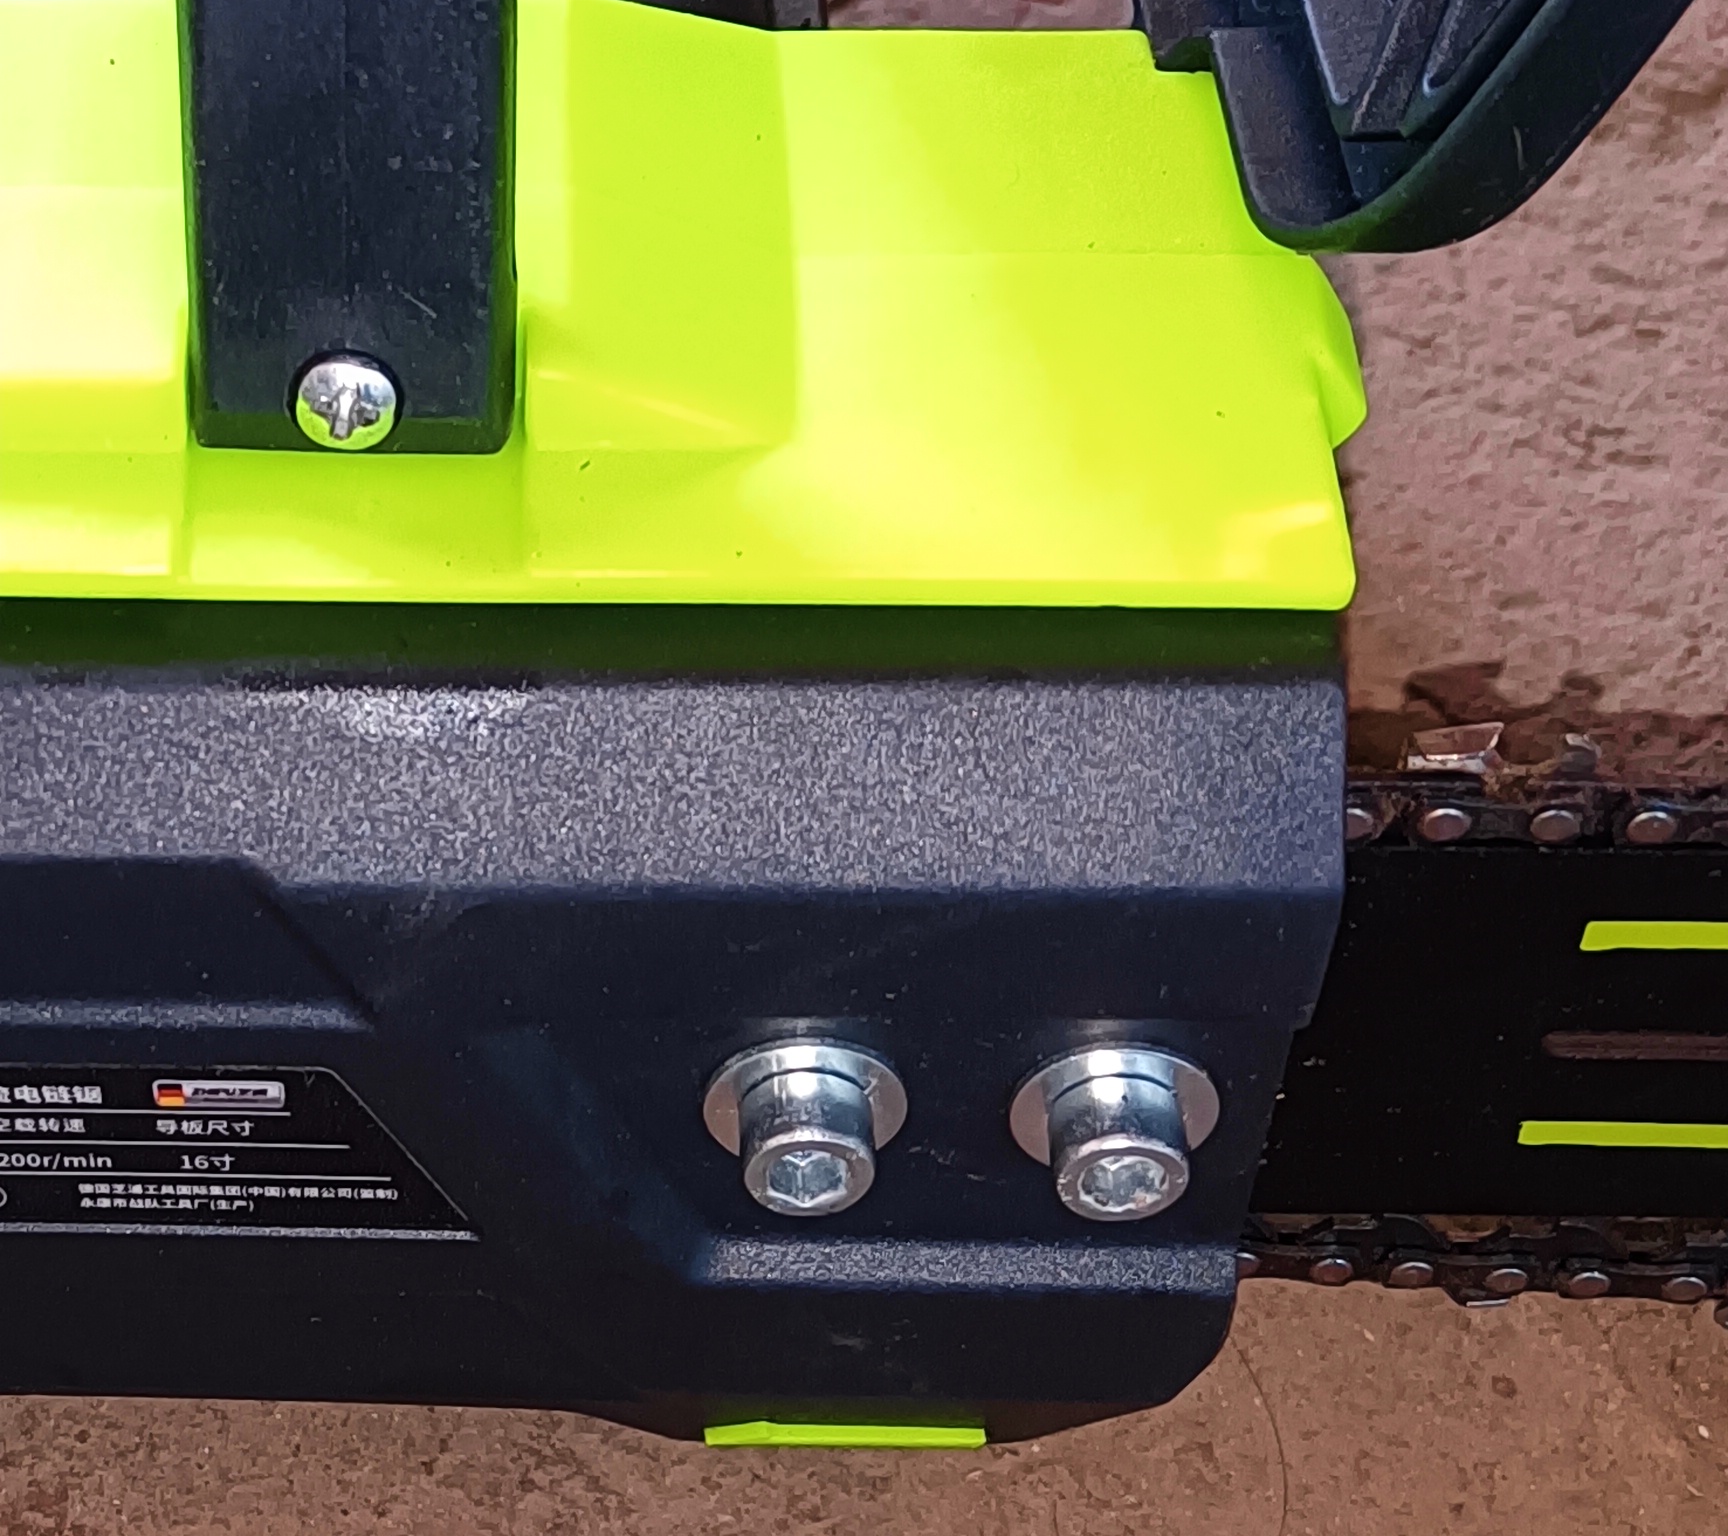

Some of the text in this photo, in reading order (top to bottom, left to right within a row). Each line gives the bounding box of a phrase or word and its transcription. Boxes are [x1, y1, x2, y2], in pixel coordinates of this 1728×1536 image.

[156, 1119, 255, 1136] 导板尺寸
[180, 1154, 236, 1172] 16寸
